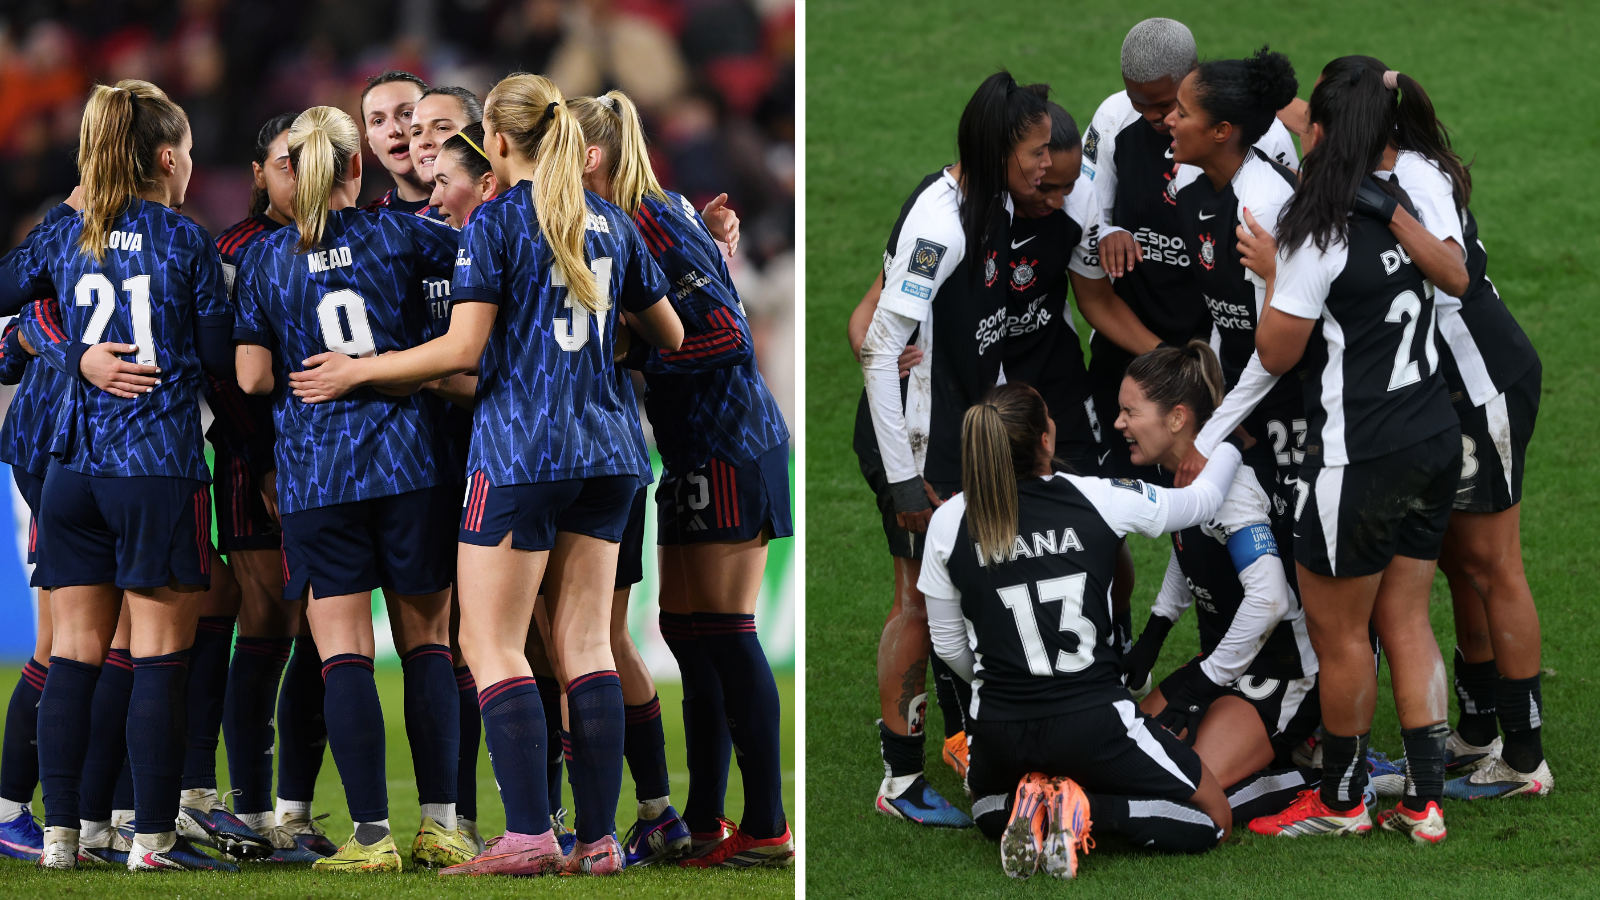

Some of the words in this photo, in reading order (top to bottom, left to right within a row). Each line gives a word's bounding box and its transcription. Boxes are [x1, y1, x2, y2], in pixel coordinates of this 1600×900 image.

[307, 246, 353, 273] MEAD
[675, 275, 712, 300] RWANDA
[677, 270, 698, 287] VISIT
[74, 273, 158, 368] 21
[995, 571, 1098, 677] 13
